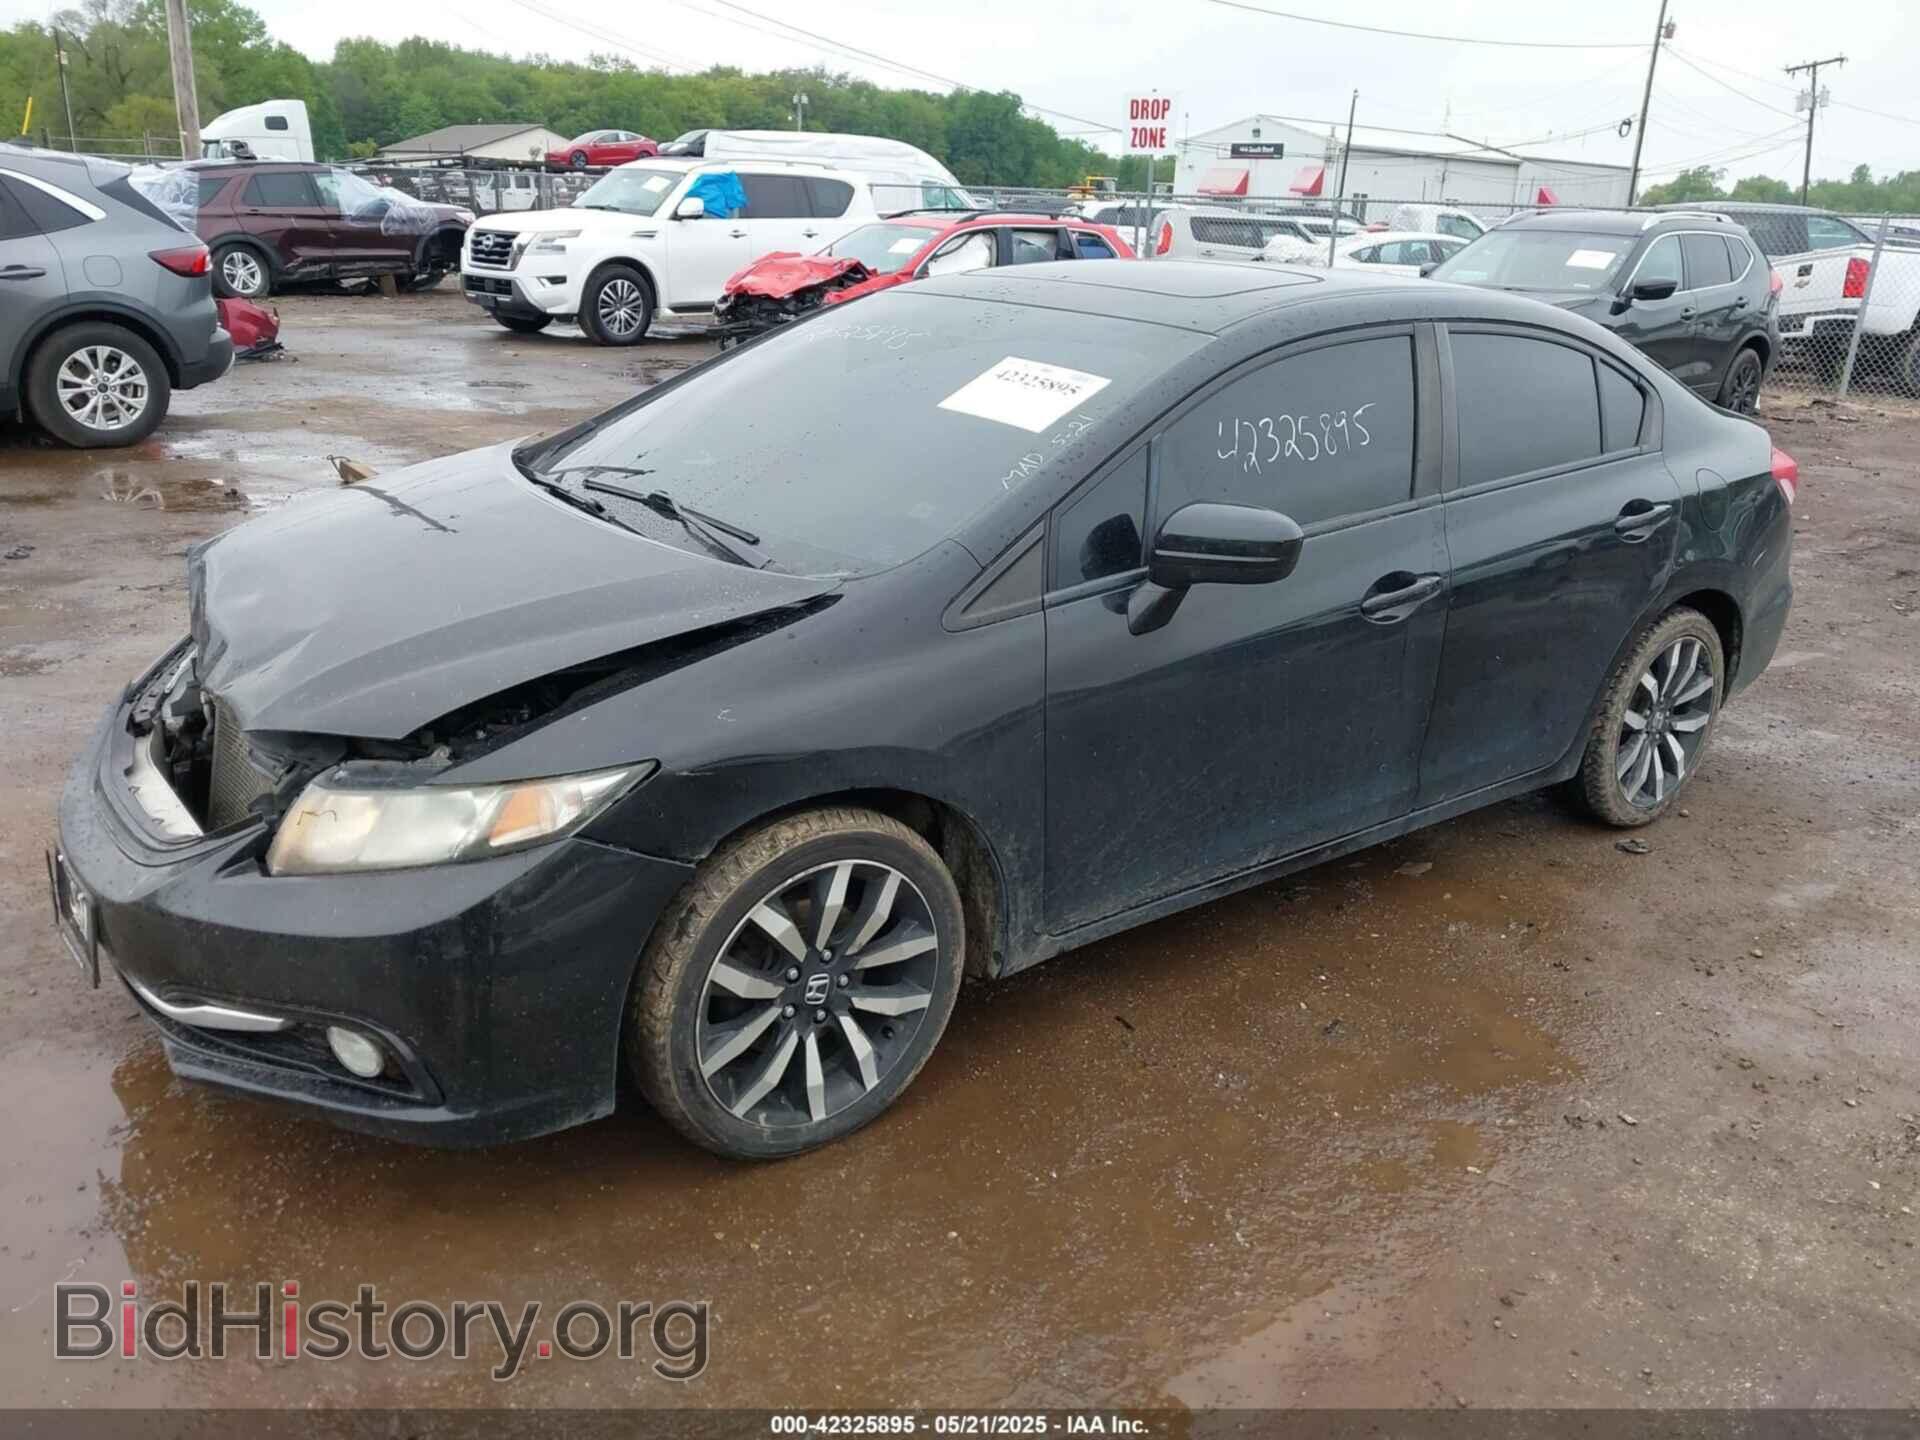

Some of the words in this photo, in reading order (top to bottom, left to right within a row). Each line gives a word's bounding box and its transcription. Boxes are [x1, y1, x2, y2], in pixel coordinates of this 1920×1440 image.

[1130, 98, 1171, 120] DROP
[1130, 127, 1167, 148] ZONE
[1216, 402, 1377, 475] 42325895
[1001, 452, 1043, 490] MAD
